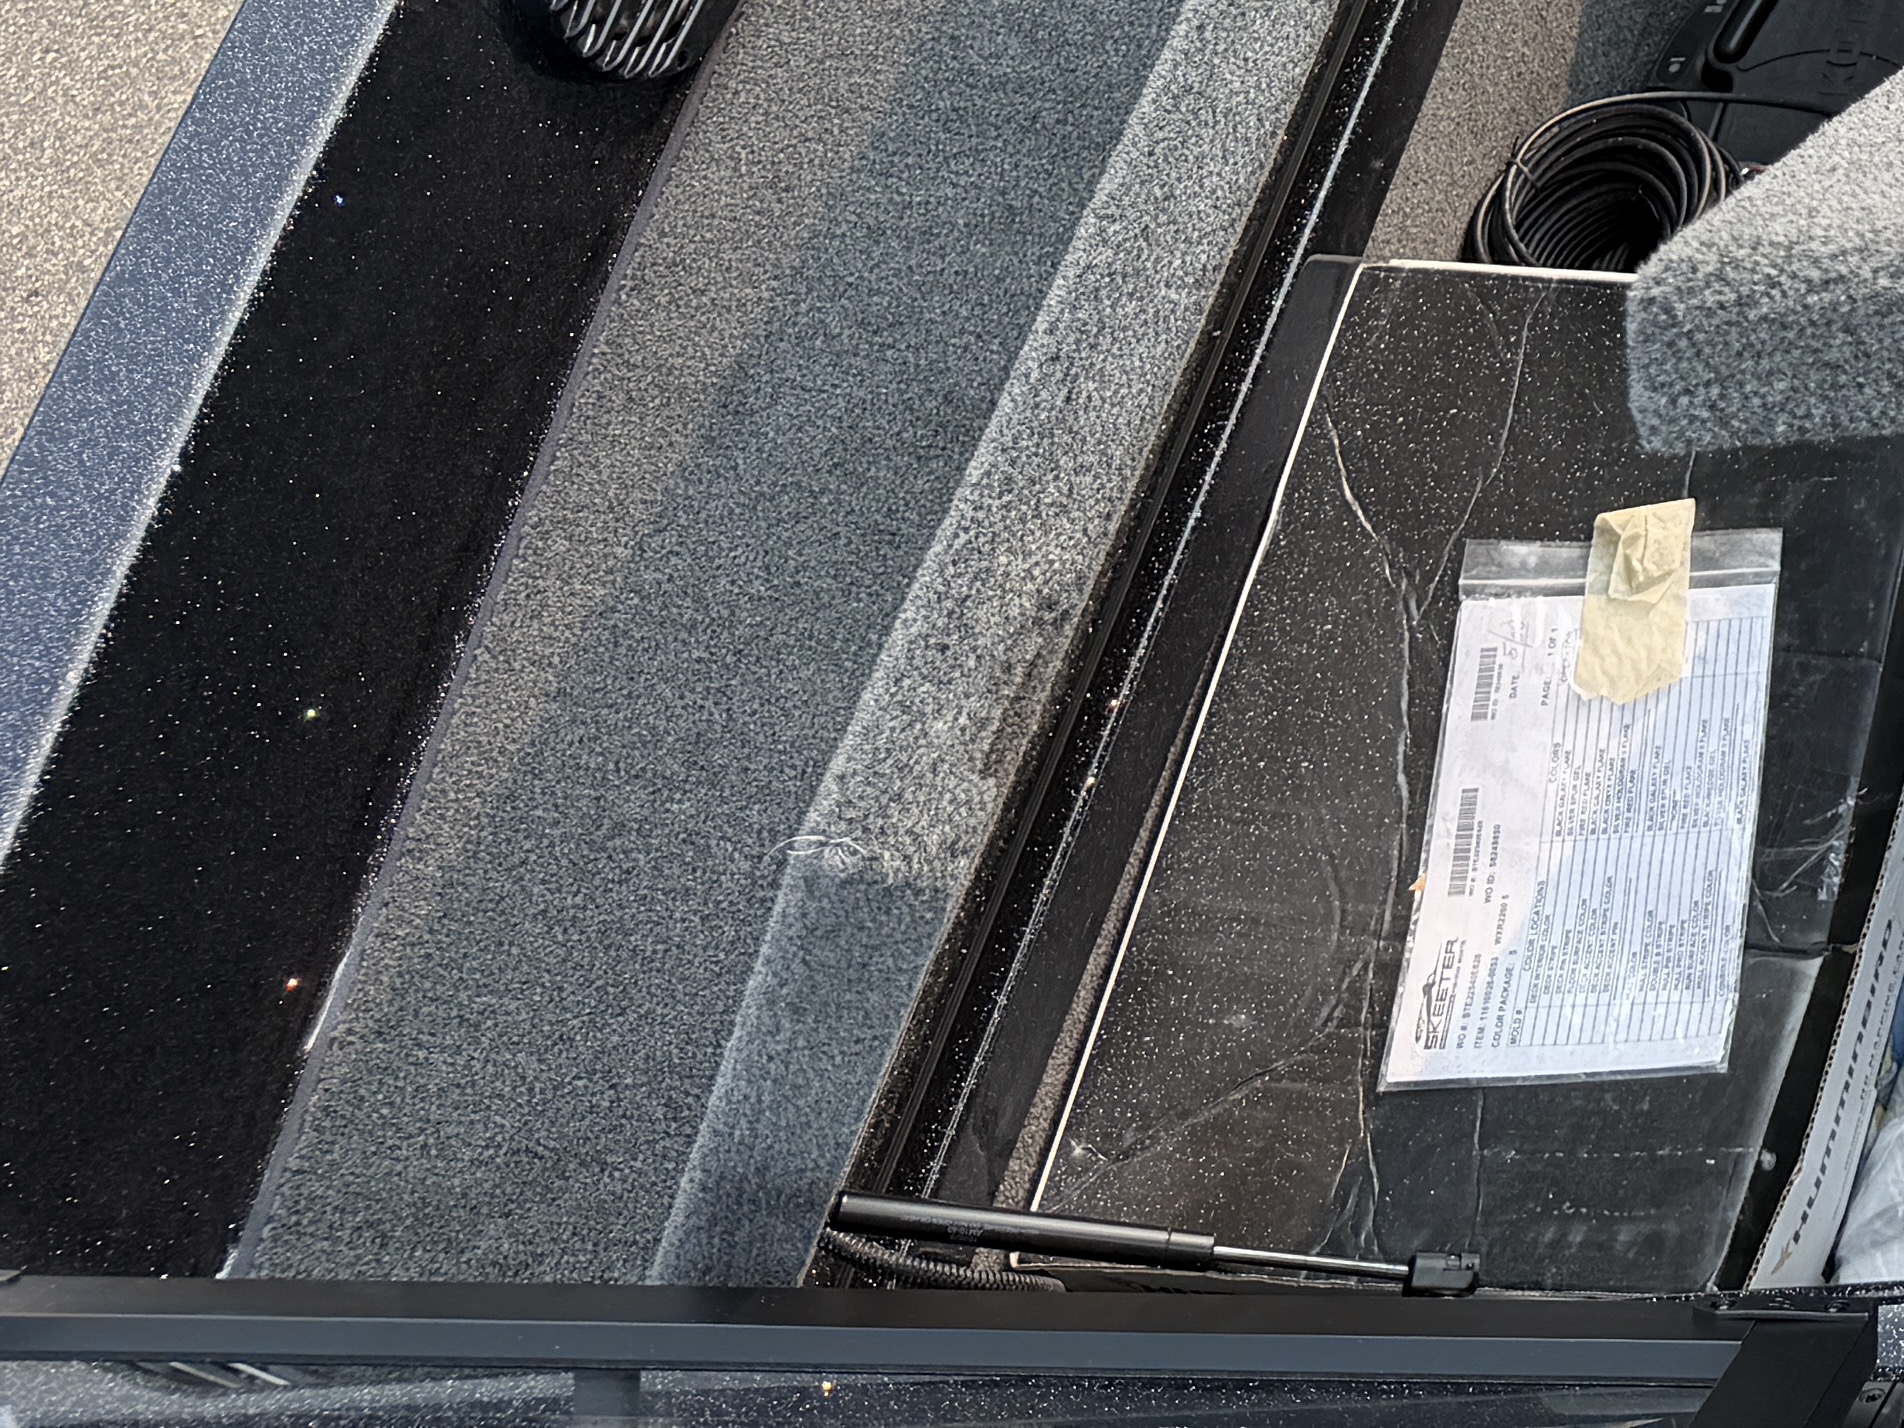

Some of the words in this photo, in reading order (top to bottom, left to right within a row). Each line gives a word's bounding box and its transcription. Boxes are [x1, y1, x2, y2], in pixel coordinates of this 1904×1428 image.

[1548, 636, 1557, 648] OF
[1548, 741, 1561, 783] COLORS
[1527, 880, 1545, 935] LOCATIONS
[1522, 938, 1536, 971] COLOR
[1423, 935, 1459, 1049] SKEETER
[1497, 961, 1515, 1012] PACKAGE:
[1491, 1014, 1505, 1048] COLOR
[1509, 1017, 1522, 1044] MOLD
[1793, 918, 1893, 1246] HUMMINBIRD
